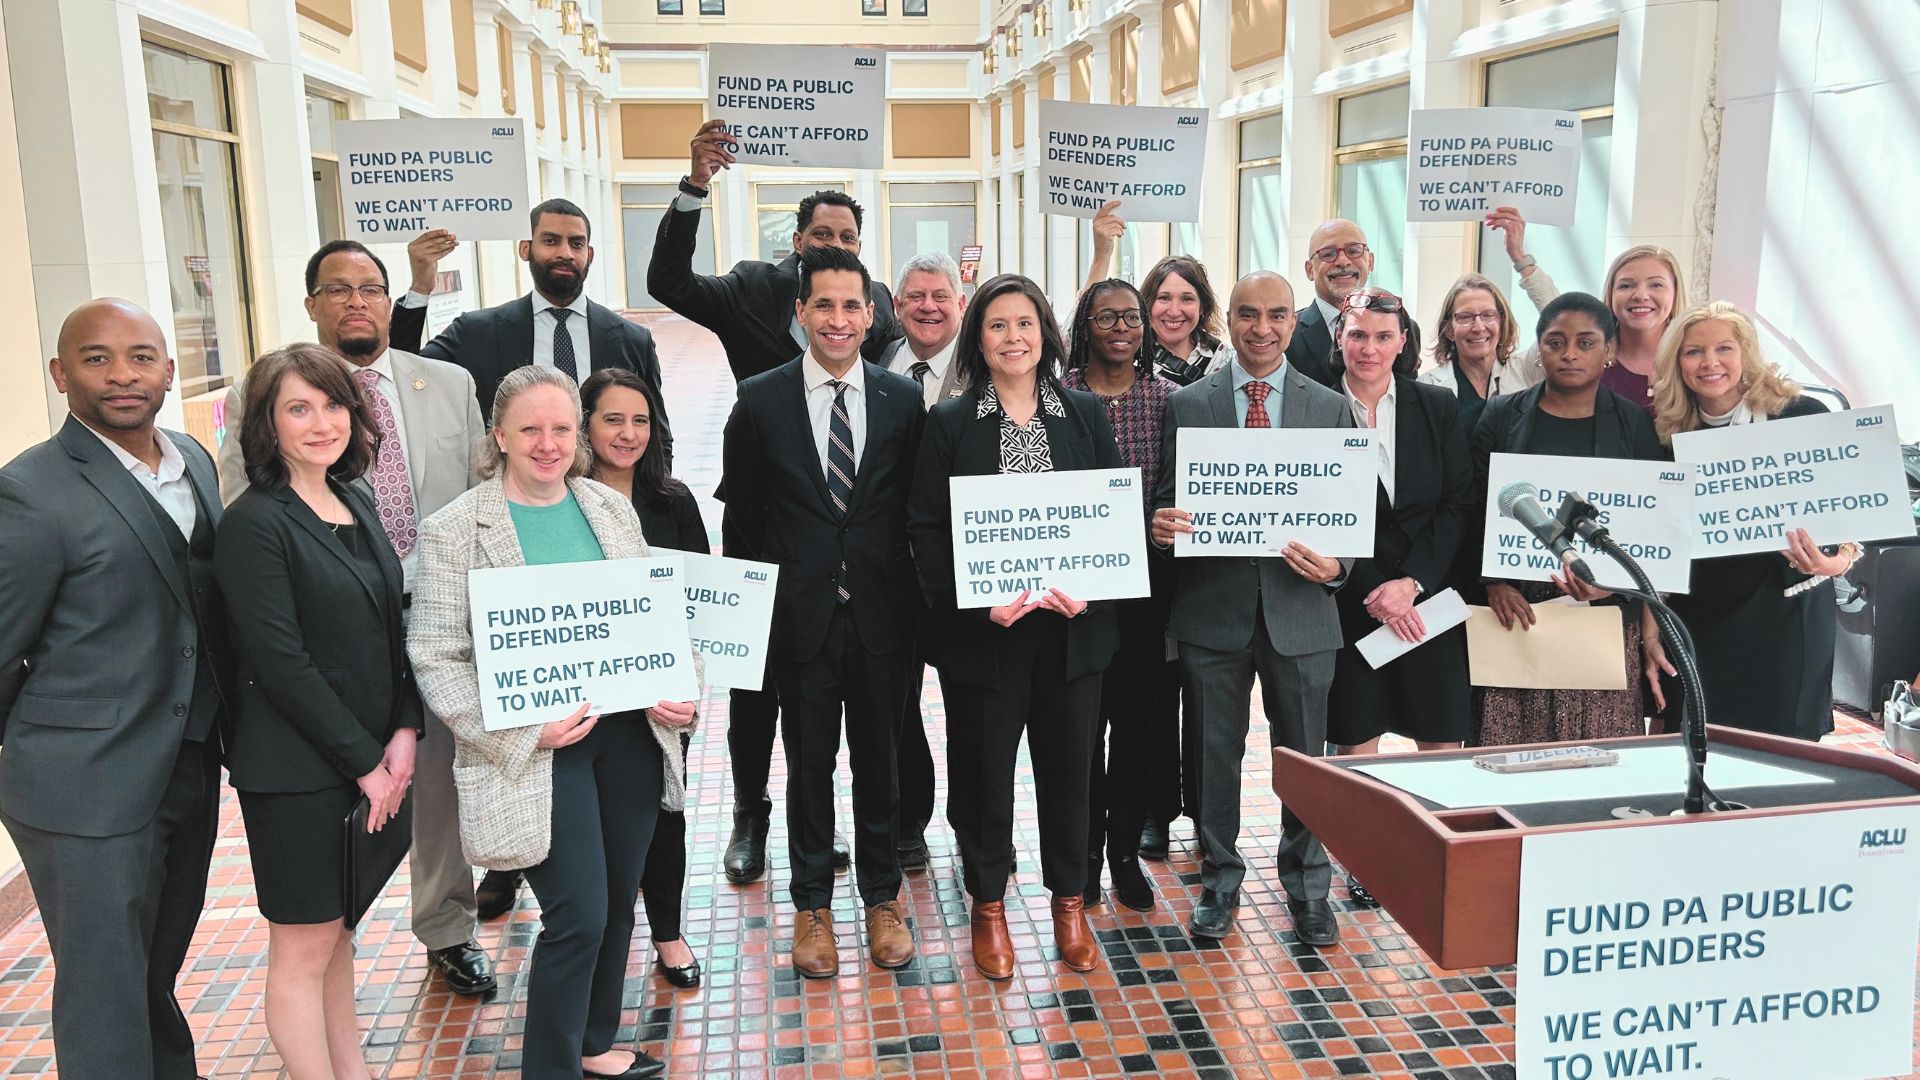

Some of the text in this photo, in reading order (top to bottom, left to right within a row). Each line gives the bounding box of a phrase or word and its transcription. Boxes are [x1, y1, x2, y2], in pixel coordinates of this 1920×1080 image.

[855, 58, 876, 66] ACLU
[718, 76, 853, 93] FUND PA PUBLIC
[718, 94, 815, 110] DEFENDERS
[1177, 117, 1198, 125] ACLU
[1555, 119, 1574, 128] ACLU
[718, 125, 868, 140] WE CAN'T AFFORD
[1049, 131, 1175, 151] FUND PA PUBLIC
[1421, 138, 1553, 151] FUND PA PUBLIC
[744, 143, 788, 156] WAIT.
[1049, 148, 1136, 167] DEFENDERS
[350, 151, 492, 166] FUND PA PUBLIC
[1420, 154, 1517, 167] DEFENDERS
[352, 169, 453, 184] DEFENDERS
[1049, 176, 1186, 196] WE CAN'T AFFORD
[1420, 181, 1563, 197] WE CAN'T AFFORD
[355, 198, 512, 214] WE CAN'T AFFORD
[1049, 192, 1106, 210] TO WAIT
[1419, 198, 1489, 211] TO WAIT.
[357, 218, 429, 232] TO WAIT.
[1856, 416, 1883, 427] ACLU
[1344, 439, 1368, 447] ACLU
[1752, 456, 1778, 470] PA
[1784, 444, 1860, 466] PUBLIC
[1188, 463, 1342, 476] FUND PA PUBLIC
[1659, 472, 1684, 481] ACLU
[1109, 478, 1131, 488] ACLU
[1188, 482, 1298, 495] DEFENDERS
[1695, 469, 1814, 496] DEFENDERS
[1588, 492, 1656, 508] PUBLIC
[964, 504, 1110, 525] FUND PA PUBLIC
[1699, 493, 1888, 526] WE CAN'T AFFORD
[1190, 512, 1357, 526] WE CAN'T AFFORD
[965, 525, 1070, 544] DEFENDERS
[1190, 531, 1266, 544] TO WAIT.
[1499, 534, 1526, 548] WE
[1702, 523, 1785, 545] TO WAIT
[968, 553, 1130, 575] WE CAN'T AFFORD
[1498, 553, 1561, 570] TO WAI
[650, 568, 673, 578] ACLU
[744, 570, 767, 581] ACLU
[969, 577, 1046, 594] TO WAIT.
[685, 587, 740, 606] UBLIC
[487, 597, 651, 628] FUND PA PUBLIC
[490, 622, 610, 650] DEFENDERS
[692, 638, 749, 657] FORD
[494, 652, 676, 689] WE CAN'T AFFORD
[497, 686, 587, 712] TO WAIT.
[1859, 828, 1906, 848] ACLU
[1545, 883, 1854, 936] FUND PA PUBLIC
[1544, 929, 1765, 976] DEFENDERS
[1544, 985, 1880, 1043] WE CAN'T AFFORD
[1544, 1042, 1702, 1080] TO WAIT.
